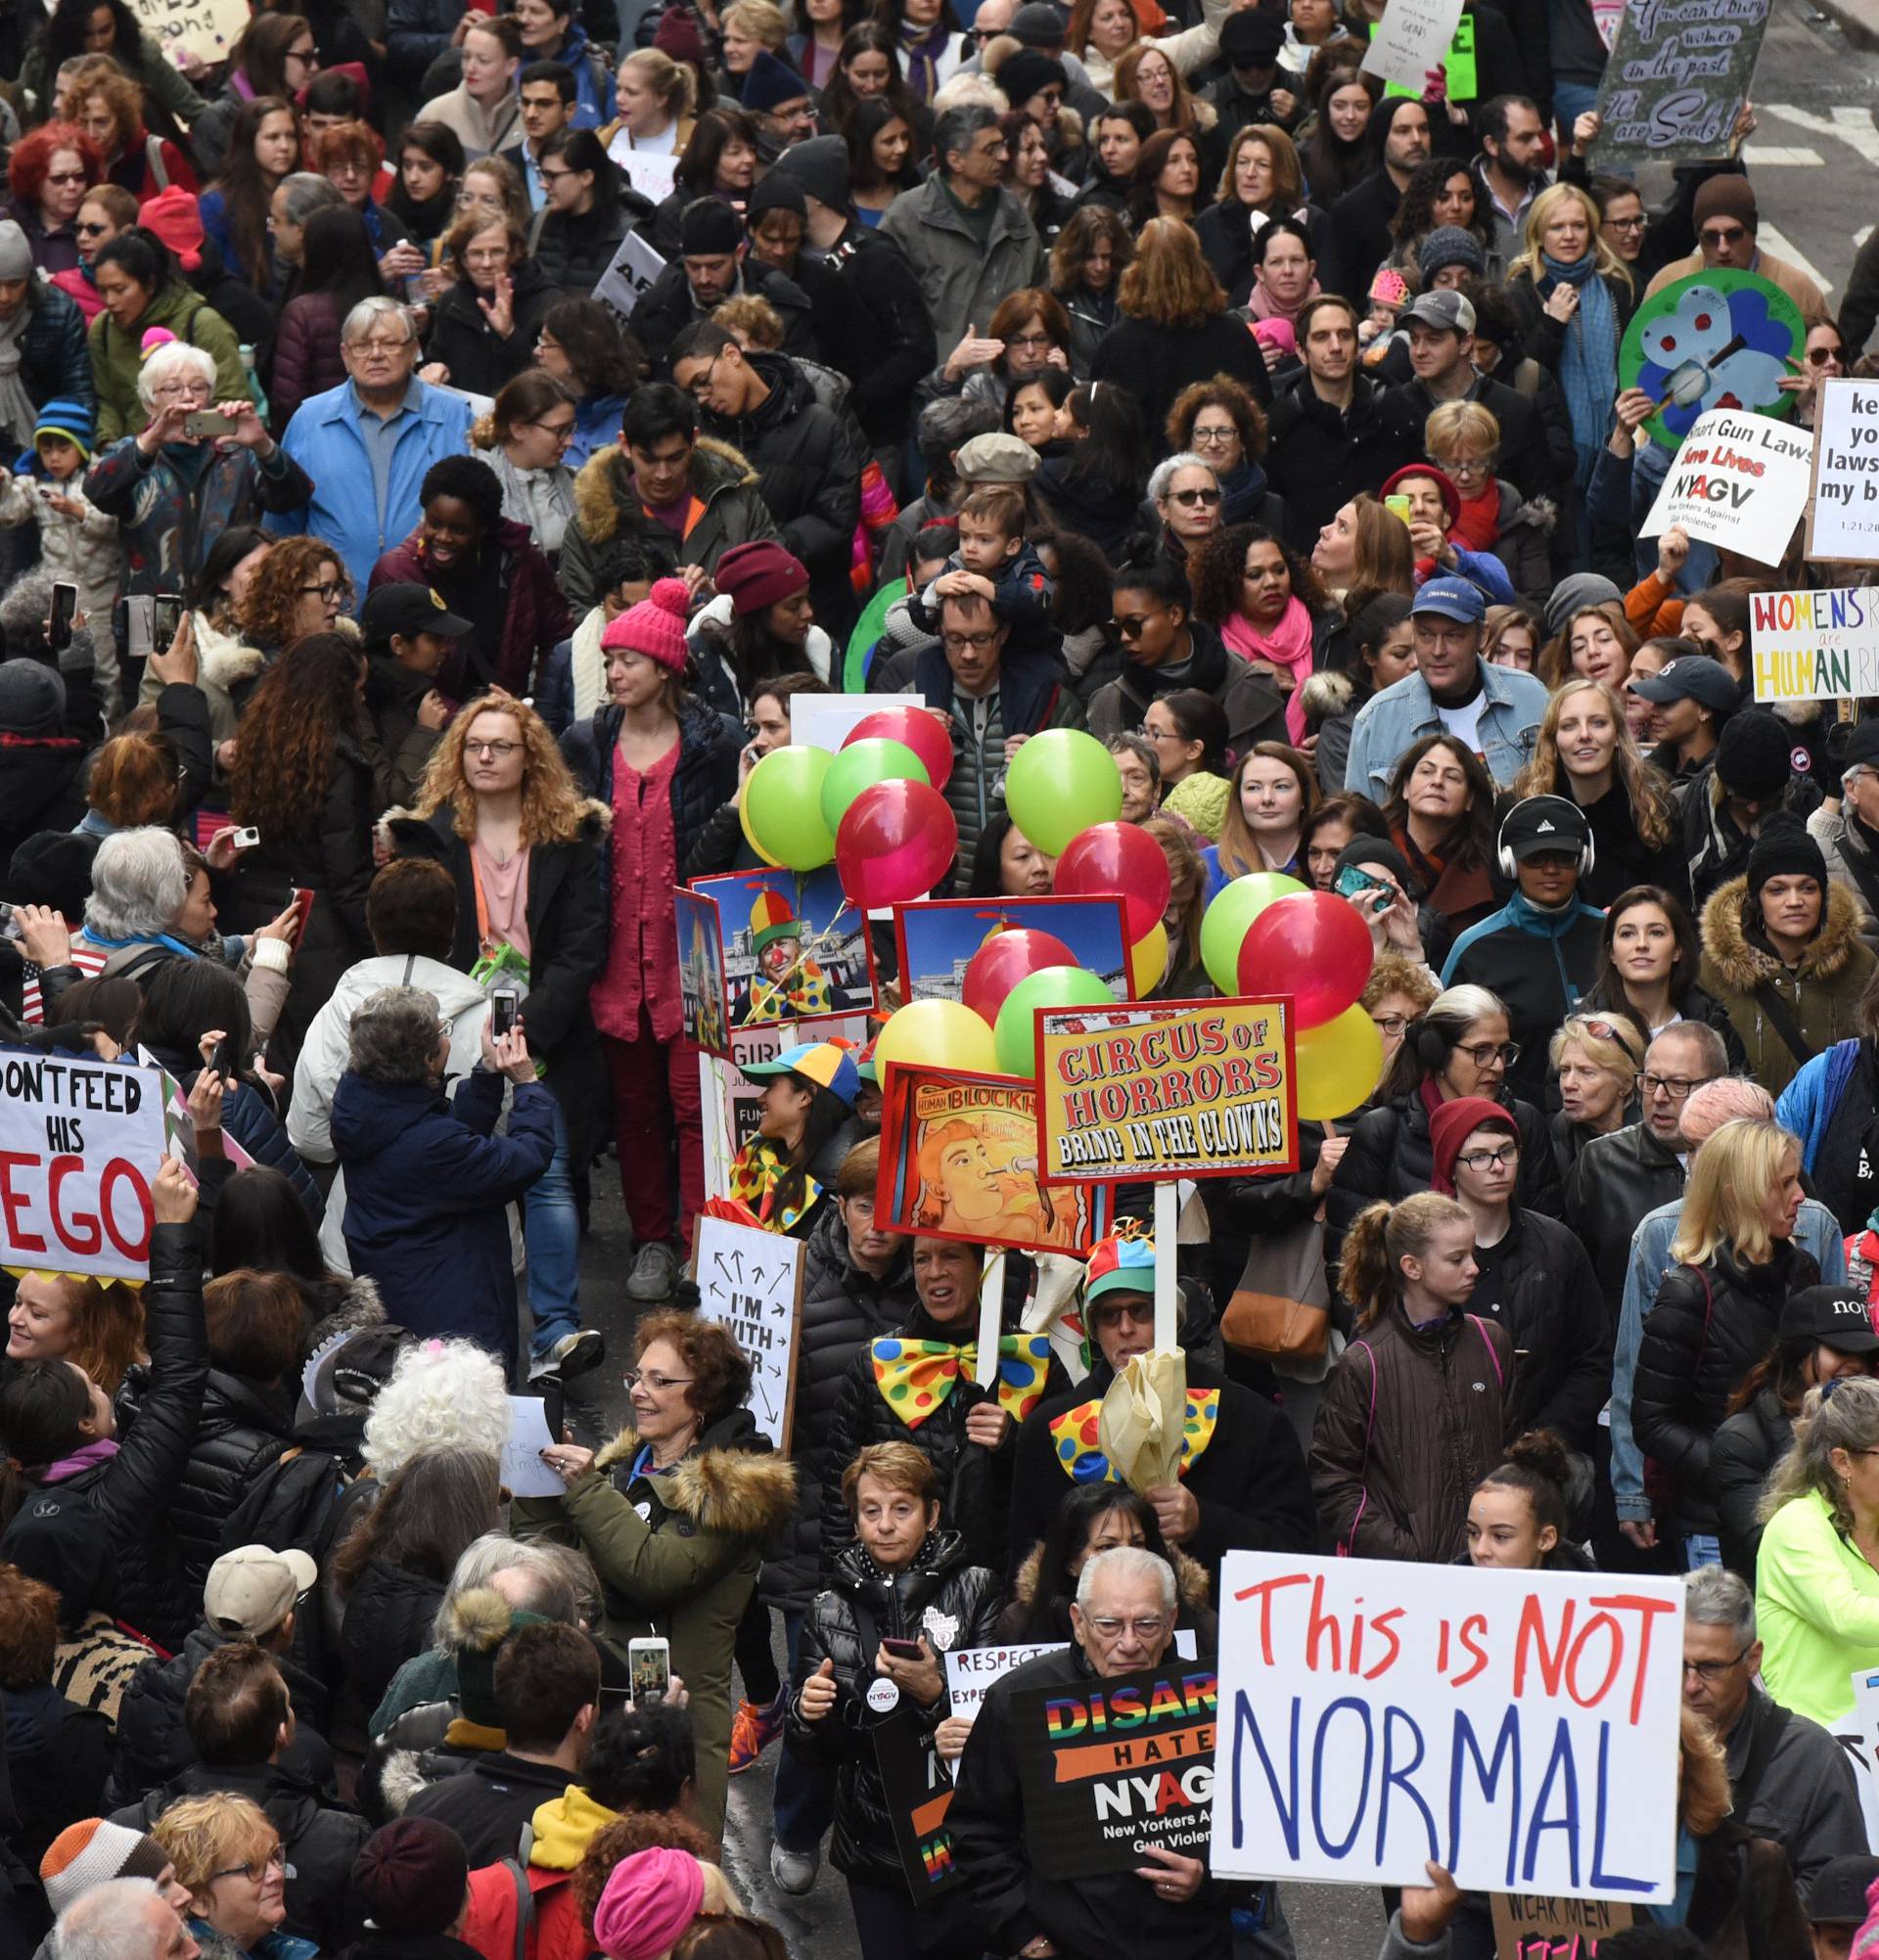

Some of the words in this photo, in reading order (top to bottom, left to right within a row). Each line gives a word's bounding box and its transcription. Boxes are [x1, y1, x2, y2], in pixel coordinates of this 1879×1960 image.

[1684, 28, 1736, 43] women
[1628, 62, 1645, 77] in
[1653, 42, 1681, 76] the
[1687, 54, 1728, 86] past
[1617, 125, 1647, 138] are
[1718, 419, 1755, 442] Gun
[1711, 445, 1766, 478] Lives
[1826, 448, 1879, 474] laws
[1671, 475, 1755, 510] NYAGV
[1820, 481, 1856, 506] my
[1680, 515, 1718, 531] Violence
[1704, 506, 1741, 525] Against
[1754, 588, 1864, 632] WOMENS
[1819, 632, 1841, 647] are
[1659, 660, 1676, 676] B
[1755, 648, 1852, 698] HUMAN
[1055, 1017, 1227, 1085] CIRCUS
[1231, 1018, 1269, 1051] OF
[69, 1068, 142, 1115] FEED
[917, 1097, 947, 1113] HUMAN
[1062, 1051, 1283, 1132] HORRORS
[46, 1116, 85, 1154] HIS
[1058, 1120, 1124, 1167] BRING
[1124, 1121, 1156, 1161] IN
[1153, 1111, 1202, 1159] THE
[1198, 1098, 1284, 1156] CLOWNS
[0, 1151, 158, 1262] EGO
[730, 1292, 763, 1321] I'M
[1233, 1573, 1407, 1681] This
[1513, 1593, 1677, 1726] NOT
[1114, 1729, 1214, 1767] HATE
[1231, 1688, 1661, 1893] NORMAL
[1103, 1823, 1136, 1840] New
[1138, 1812, 1196, 1836] Yorkers
[1132, 1837, 1166, 1854] Gun
[1507, 1893, 1561, 1926] WEAK
[1566, 1898, 1611, 1931] MEN
